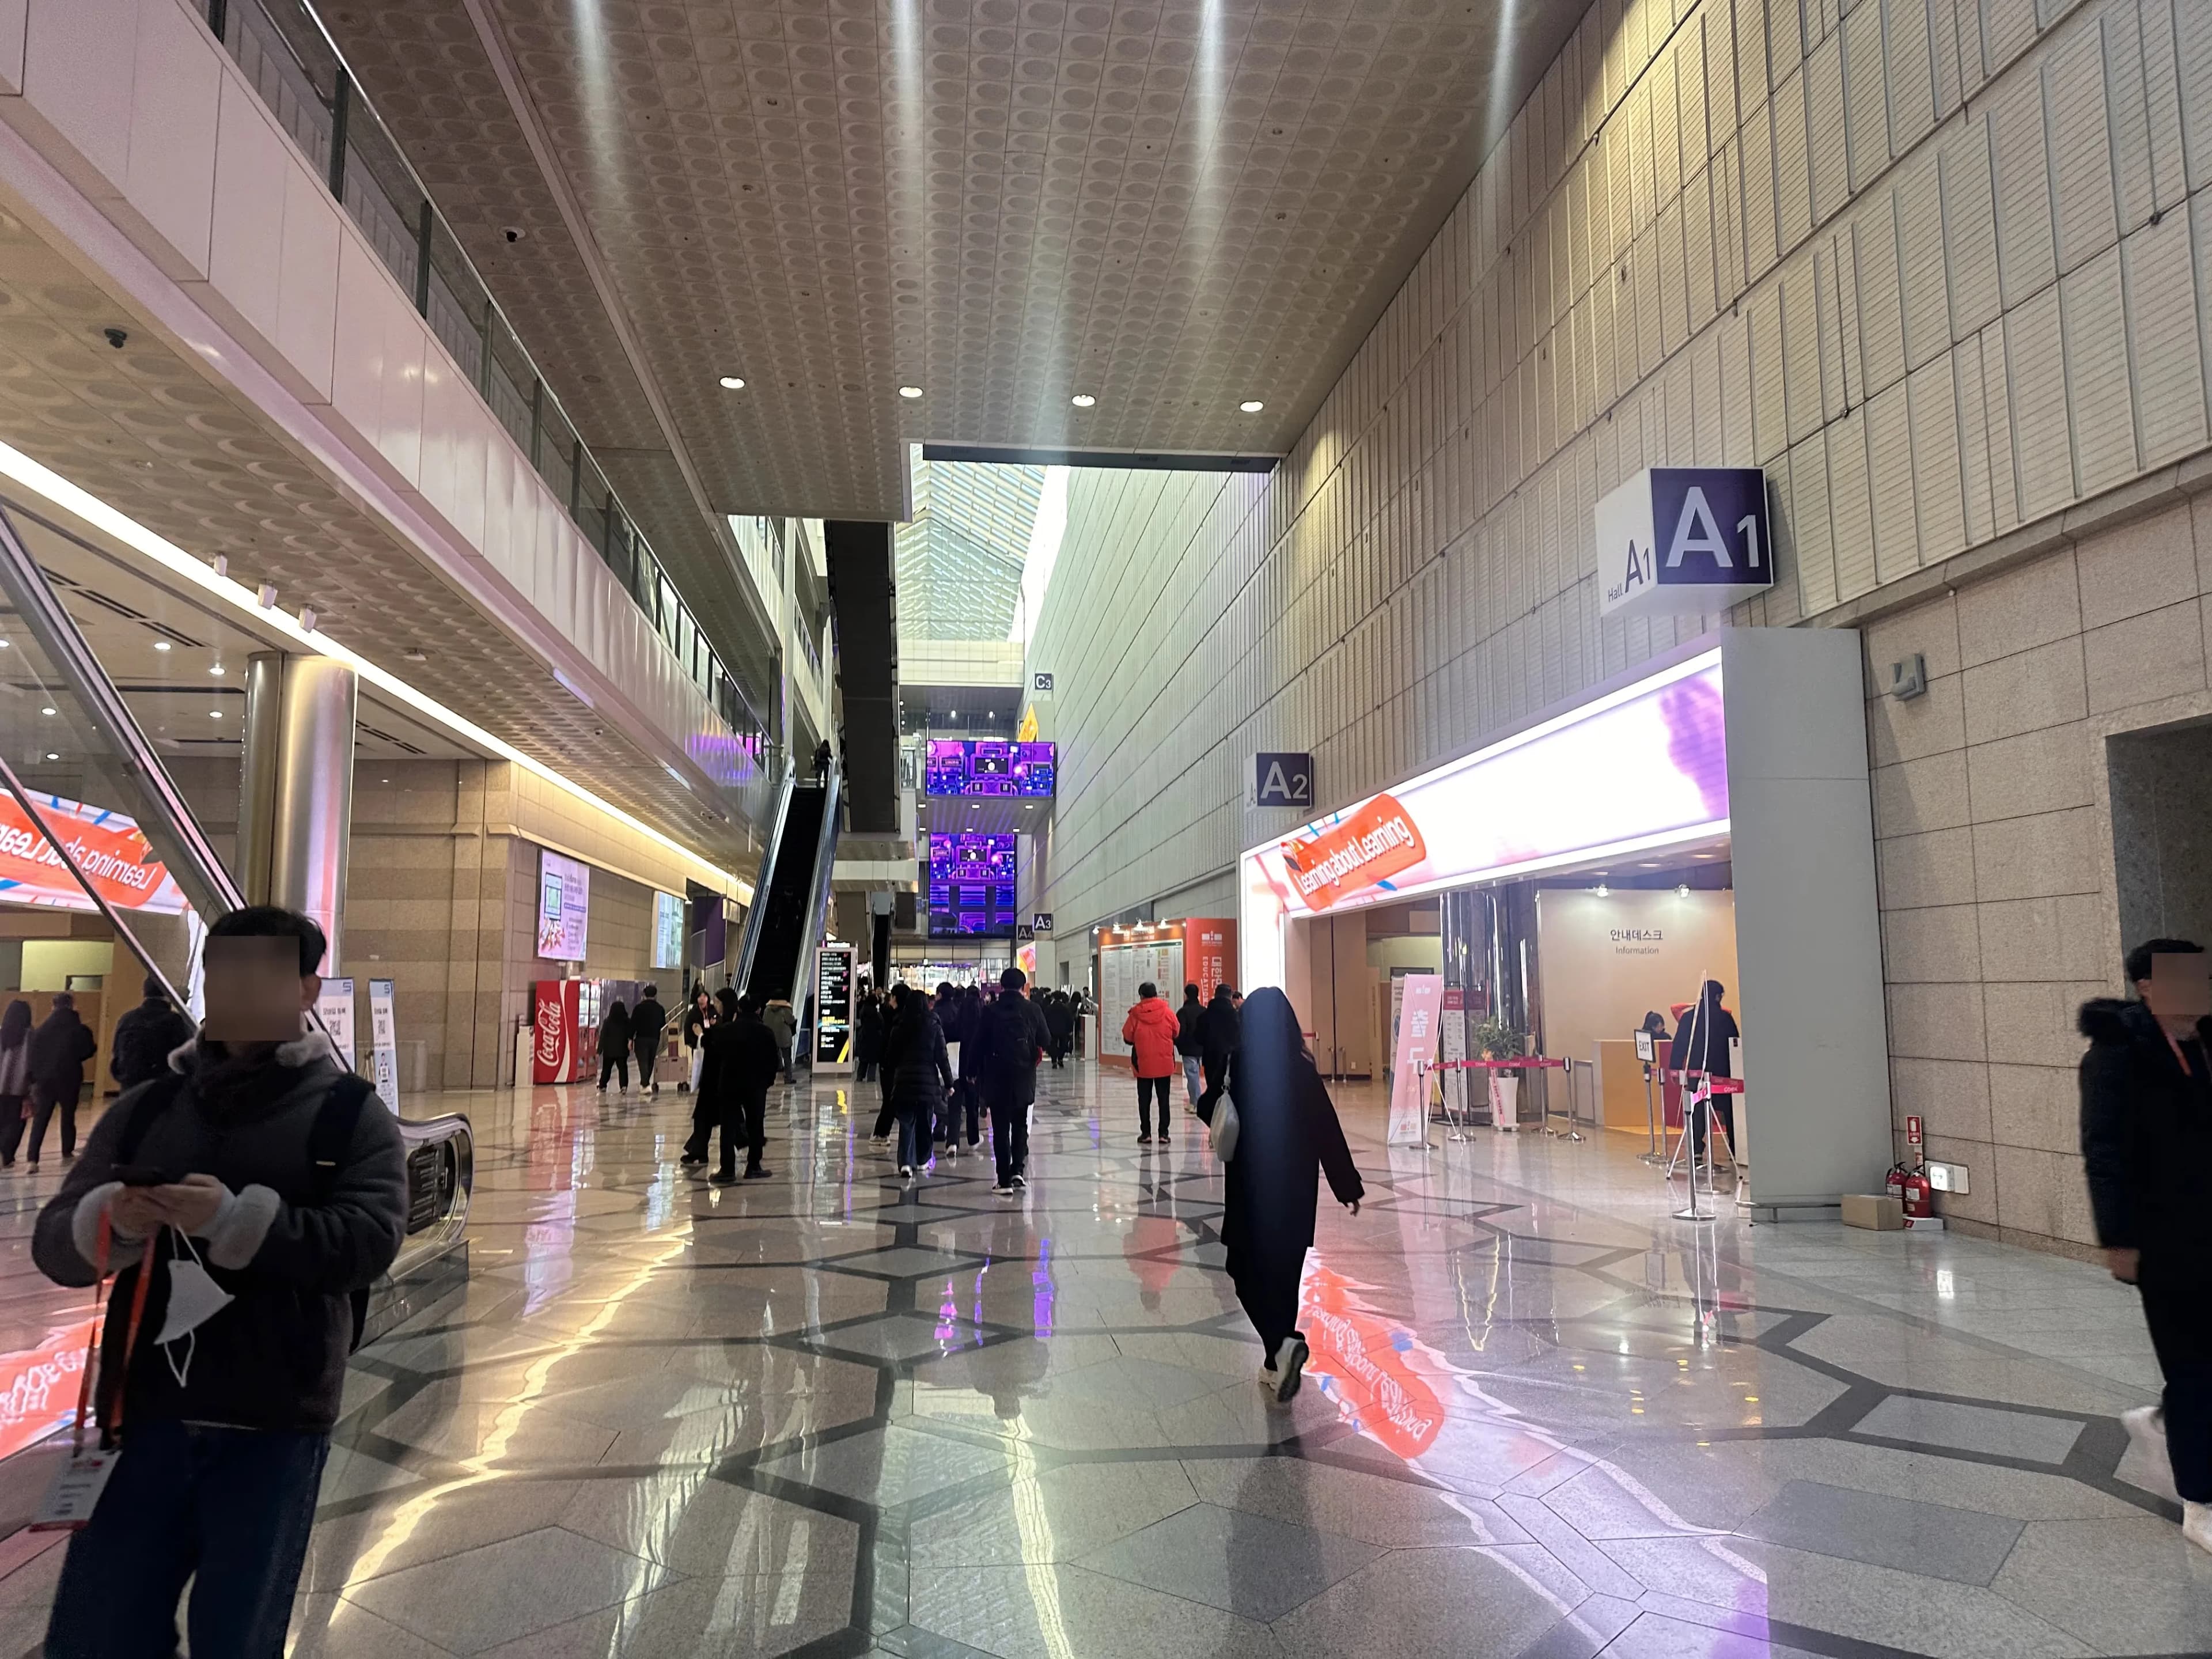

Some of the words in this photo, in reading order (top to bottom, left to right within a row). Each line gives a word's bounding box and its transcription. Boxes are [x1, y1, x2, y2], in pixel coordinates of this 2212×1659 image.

[1666, 487, 1759, 567] A1
[1608, 583, 1623, 603] Hall
[1624, 539, 1650, 593] A1
[1036, 675, 1051, 688] C3
[1260, 761, 1308, 799] A2
[1294, 859, 1340, 895] Learning
[1330, 840, 1361, 878] about
[1351, 816, 1415, 864] Learning
[1035, 915, 1051, 929] A3
[1018, 927, 1032, 938] A4
[1610, 929, 1663, 941] 안내데스크
[1616, 946, 1659, 955] Information
[1639, 1040, 1649, 1052] EXIT
